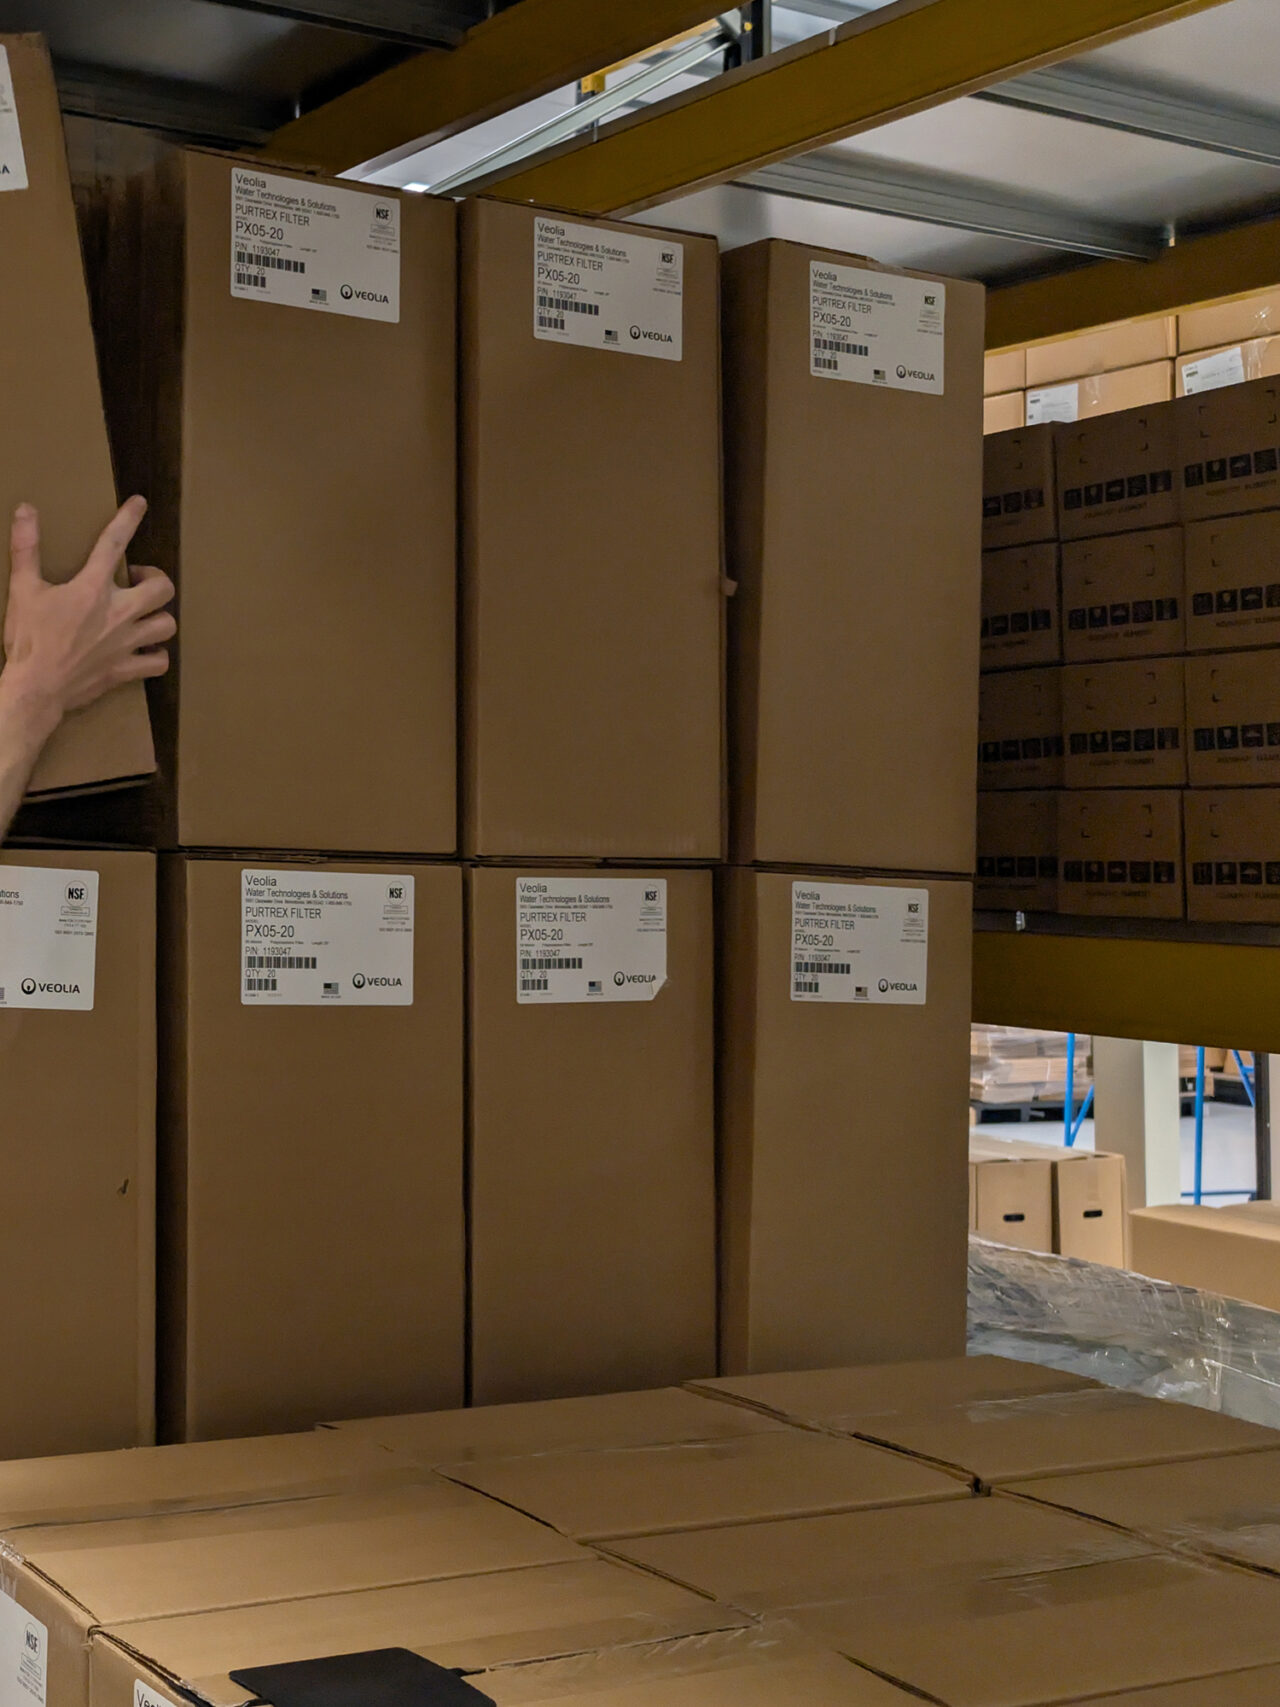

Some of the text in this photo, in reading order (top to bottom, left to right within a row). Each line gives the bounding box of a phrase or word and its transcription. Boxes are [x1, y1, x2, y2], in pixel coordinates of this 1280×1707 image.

[236, 174, 266, 188] Veolia
[235, 186, 254, 196] Water
[256, 189, 299, 206] Technologies
[307, 200, 336, 212] Solutions
[236, 204, 277, 220] PURTREX
[280, 212, 310, 226] FILTER
[376, 210, 389, 220] NSF
[236, 221, 284, 240] PX05-20
[538, 223, 565, 236] Veolia
[538, 251, 574, 265] PURTREX
[576, 258, 603, 271] FILTER
[662, 253, 674, 264] NSF
[538, 267, 580, 284] PX05-20
[354, 290, 389, 304] VEOLIA
[848, 301, 871, 314] FILTER
[813, 311, 851, 327] PX05-20
[642, 331, 672, 343] VEOLIA
[908, 369, 935, 381] VEOLIA
[245, 875, 276, 886] Veolia
[68, 888, 84, 900] NSF
[245, 888, 265, 897] Water
[268, 888, 310, 900] Technologies
[319, 890, 348, 900] Solutions
[389, 888, 402, 899] NSF
[520, 883, 548, 893] Veolia
[645, 891, 658, 901] NSF
[795, 890, 820, 900] Veolia
[245, 906, 321, 919] PURTREX FILTER
[908, 904, 919, 914] NSF
[520, 912, 586, 922] PURTREX FILTER
[795, 918, 854, 930] PURTREX FILTER
[245, 924, 294, 938] PX05-20
[520, 929, 563, 940] PX05-20
[795, 934, 833, 946] PX05-20
[367, 977, 402, 987] VEOLIA
[626, 975, 656, 984] VEOLIA
[38, 983, 80, 994] VEOLIA
[889, 982, 918, 991] VEOLIA
[26, 1631, 38, 1653] NSF
